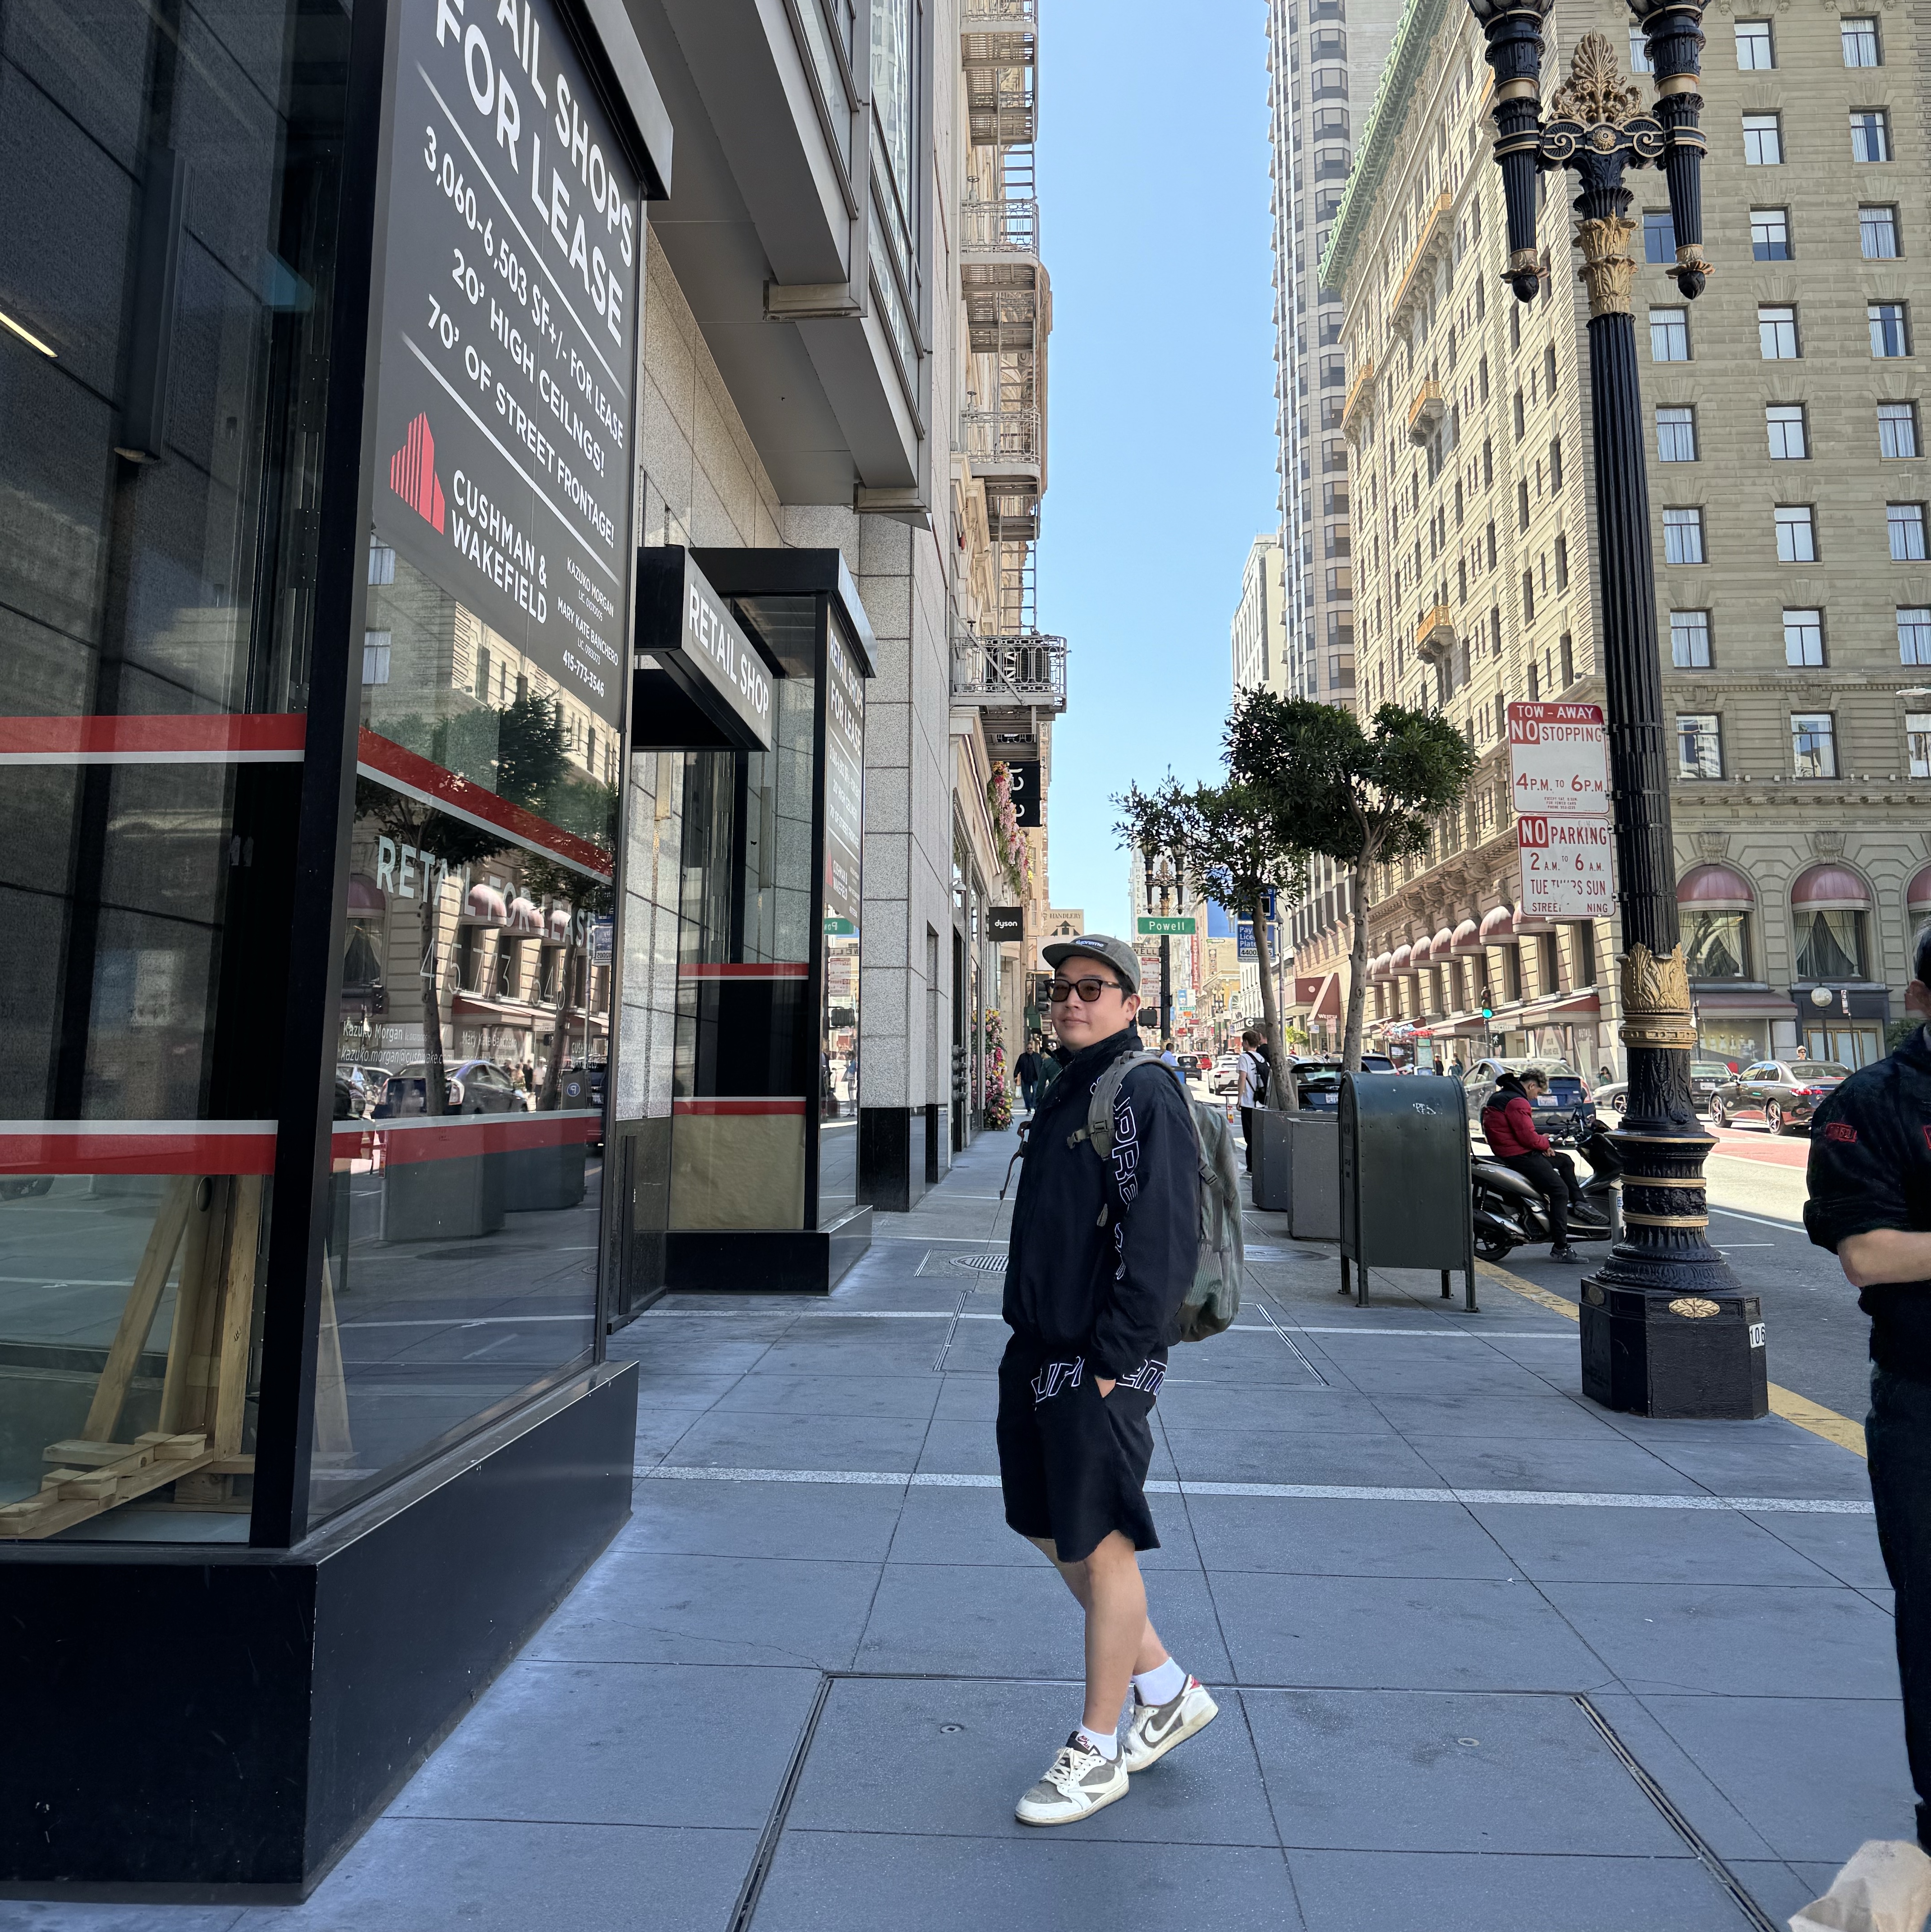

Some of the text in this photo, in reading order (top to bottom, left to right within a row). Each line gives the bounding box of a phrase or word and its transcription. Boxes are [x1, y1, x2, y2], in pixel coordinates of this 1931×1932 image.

[497, 0, 632, 267] AIL SHOPS
[532, 132, 623, 348] LEASE
[424, 126, 527, 306] 3,060-6,503
[571, 349, 592, 404] FOR
[595, 384, 623, 449] LEASE
[491, 298, 534, 384] HIGH
[539, 369, 604, 477] CEILNGS!
[465, 345, 491, 391] OF
[496, 382, 555, 473] STREET
[557, 458, 614, 549] FRONTAGE!
[453, 469, 547, 589] CUSHMAN &
[452, 509, 547, 624] WAKEFIELD
[567, 557, 591, 592] KAZUKO
[592, 583, 614, 618] MORGAN
[558, 597, 574, 624] MARY
[576, 614, 589, 639] KATE
[591, 629, 618, 666] BANCHERO
[688, 584, 769, 720] RETAIL SHOP
[563, 649, 604, 698] 415-773-3546
[830, 628, 863, 718] RETAIL SHOPS
[831, 679, 844, 729] FOR
[844, 704, 861, 757] LEASE
[1510, 720, 1602, 742] NO STOPPING
[1555, 780, 1564, 788] TO
[1521, 819, 1606, 845] NO PARKING
[1530, 852, 1540, 871] 2
[1544, 862, 1560, 871] A.M.
[1575, 854, 1584, 871] 6
[1589, 862, 1604, 872] A.M.
[1530, 879, 1548, 895] TUE
[1587, 880, 1606, 895] SUN
[995, 919, 1018, 929] dyson
[1149, 921, 1184, 931] Powell
[1587, 903, 1608, 913] NING
[343, 1020, 372, 1038] Kazuko
[375, 1024, 403, 1042] Morgan
[462, 1031, 477, 1047] Mary
[1750, 1326, 1765, 1345] 106
